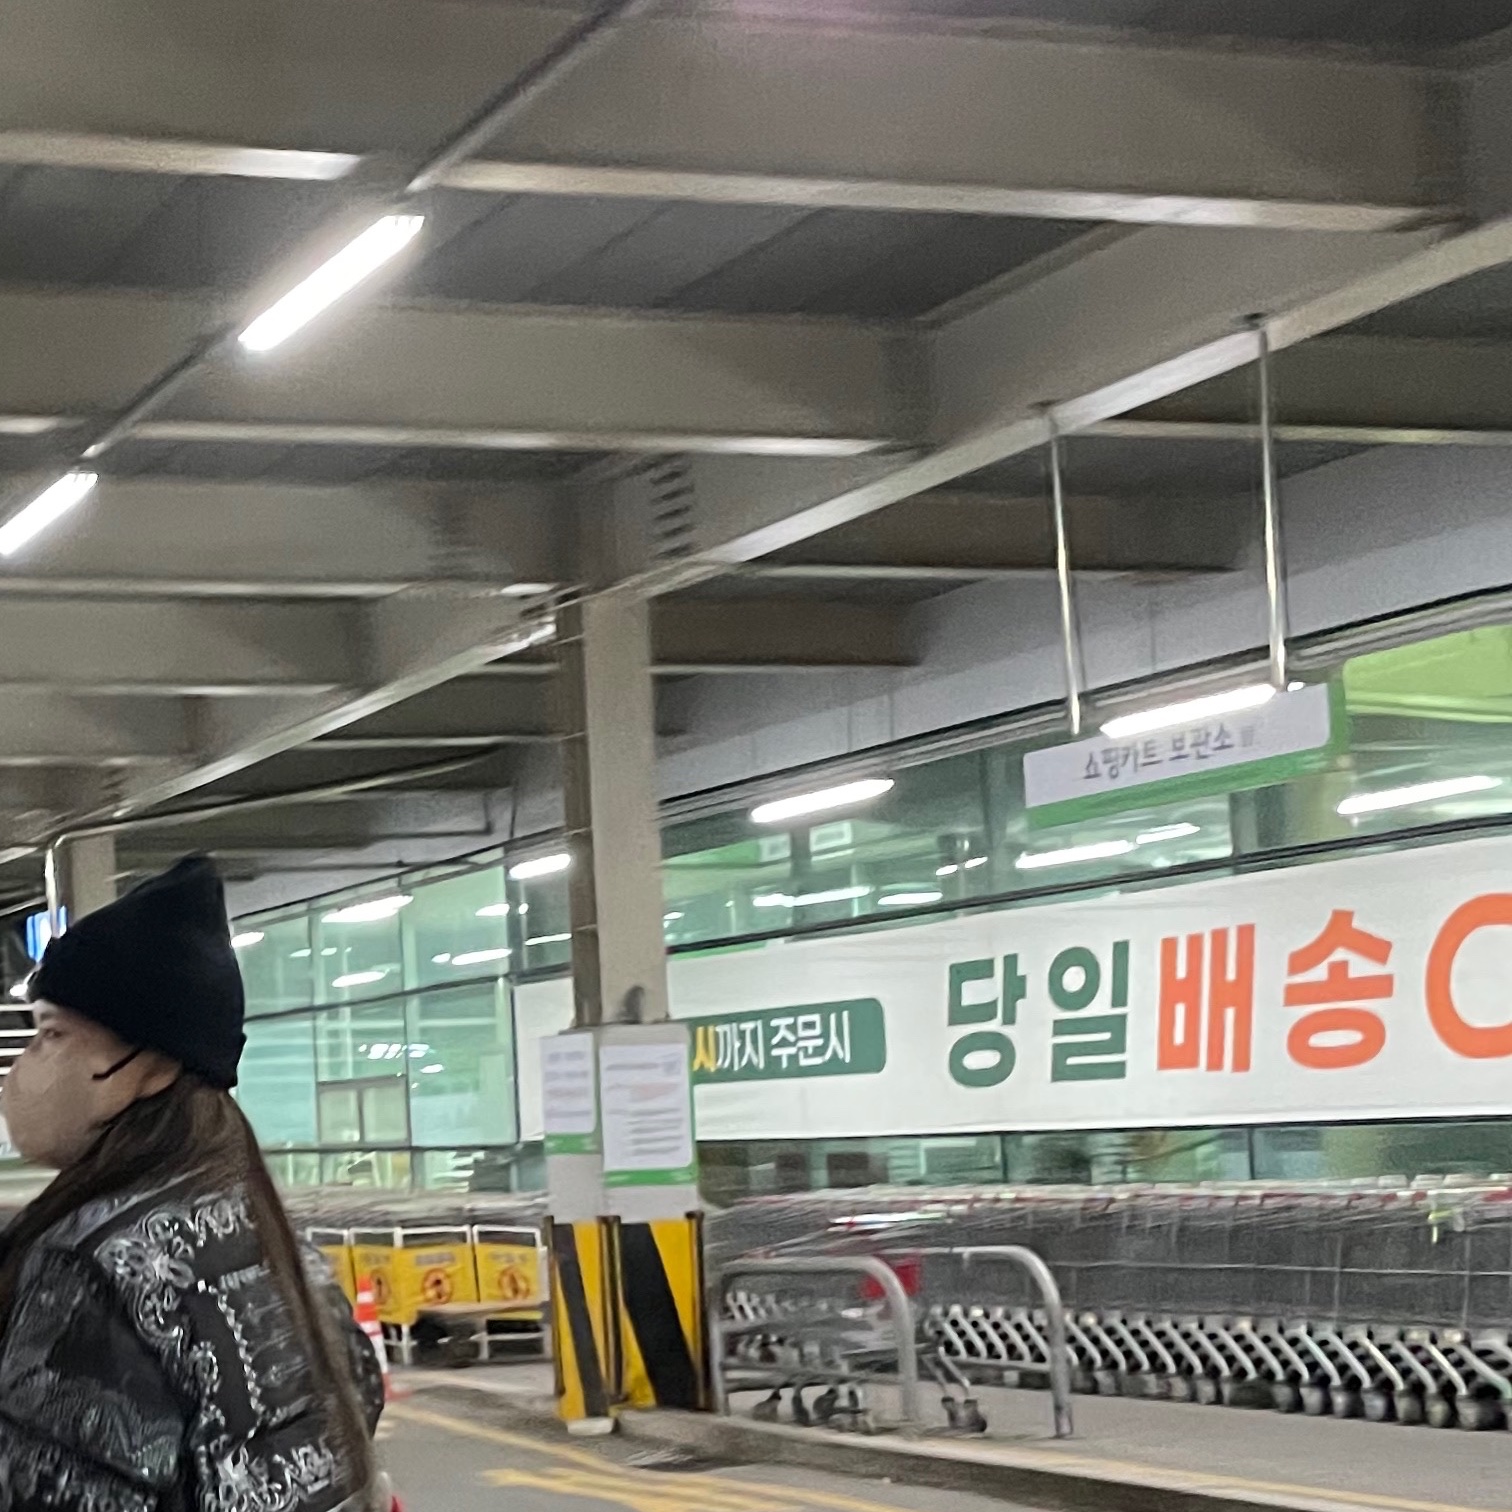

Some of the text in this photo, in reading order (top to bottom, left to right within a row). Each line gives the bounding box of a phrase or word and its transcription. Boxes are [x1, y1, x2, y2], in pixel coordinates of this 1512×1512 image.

[1083, 722, 1234, 779] 쇼핑카트 보관소
[770, 1010, 851, 1069] 주문시
